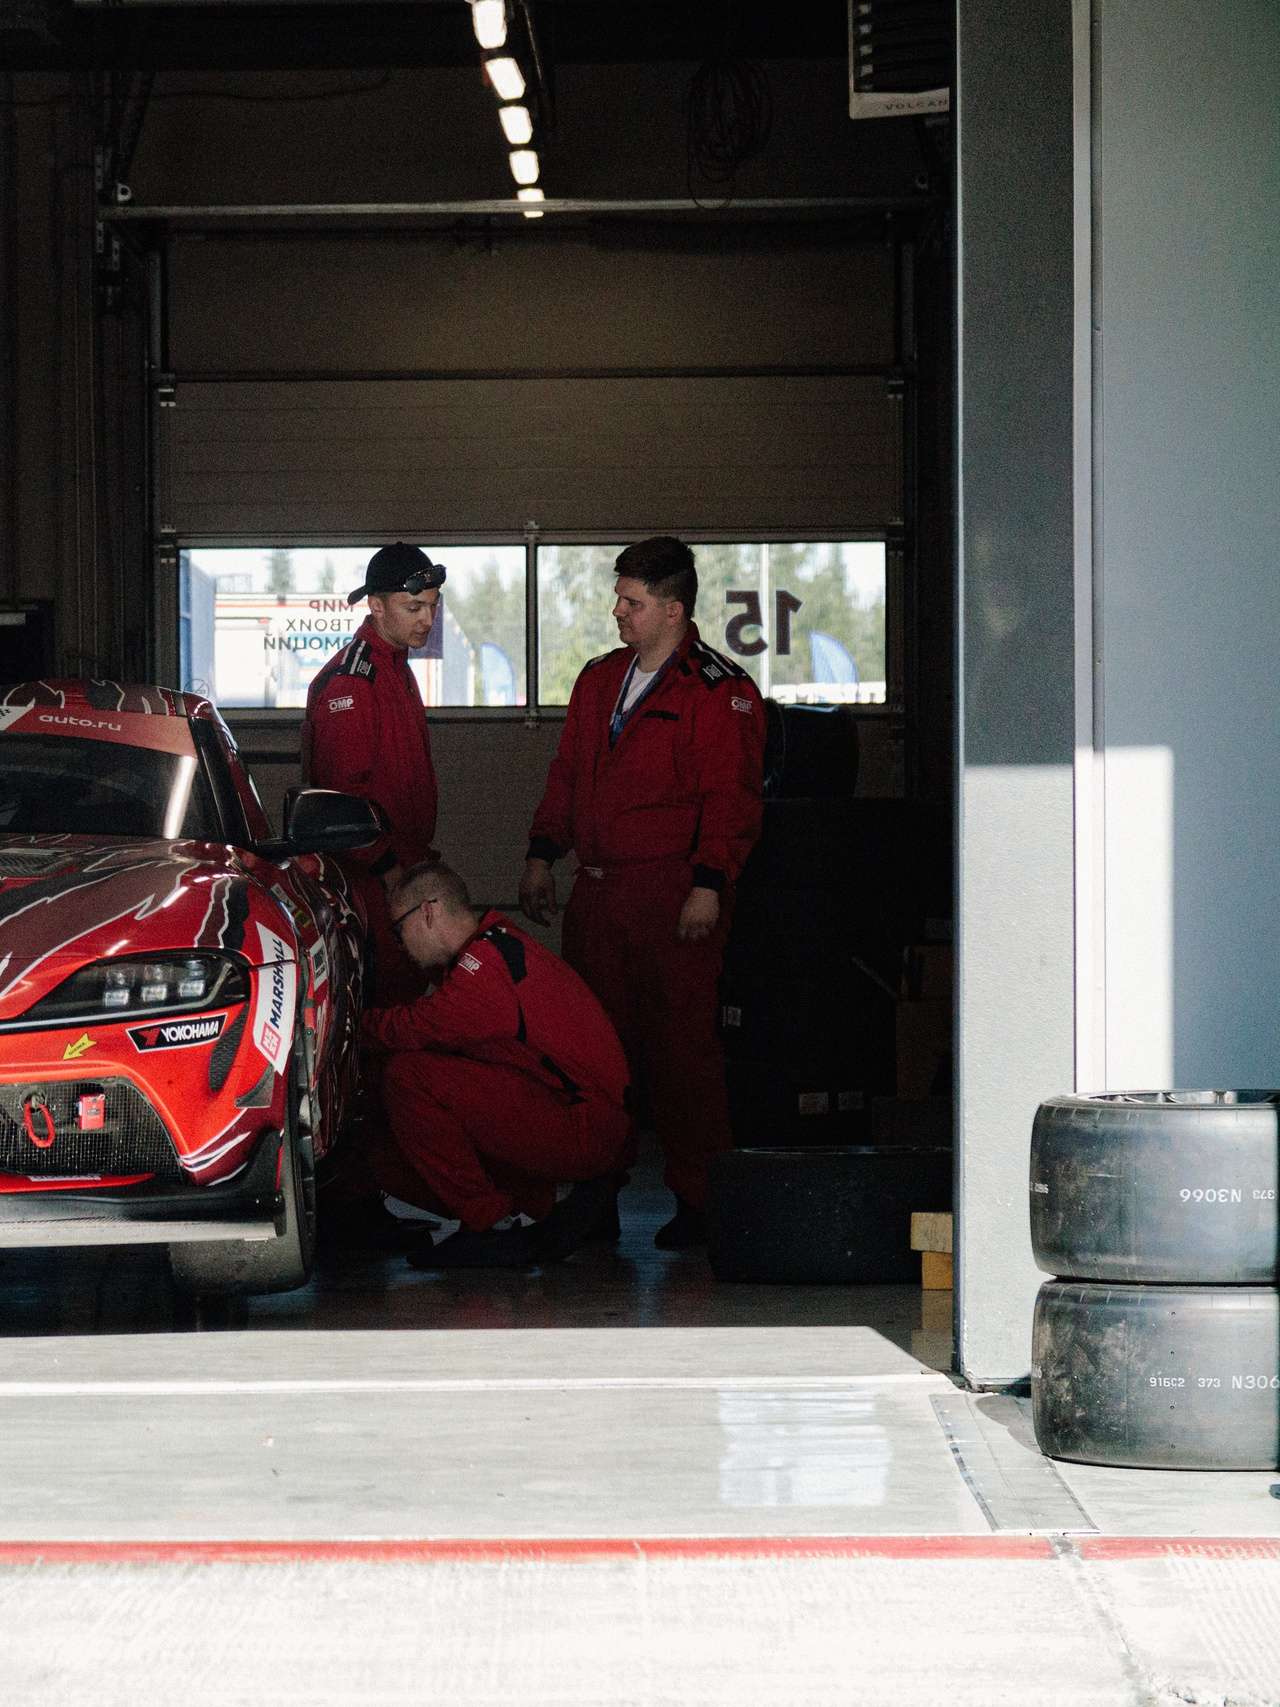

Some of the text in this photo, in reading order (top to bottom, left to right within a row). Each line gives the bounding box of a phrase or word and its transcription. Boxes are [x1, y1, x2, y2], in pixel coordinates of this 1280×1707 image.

[329, 697, 354, 711] OMP
[731, 698, 753, 711] OMP
[39, 715, 121, 731] auto.ru
[269, 938, 285, 1029] MARSHALL
[161, 1020, 220, 1042] YOKOHAMA
[1179, 1188, 1275, 1203] 373 N3066
[1198, 1378, 1221, 1388] 373
